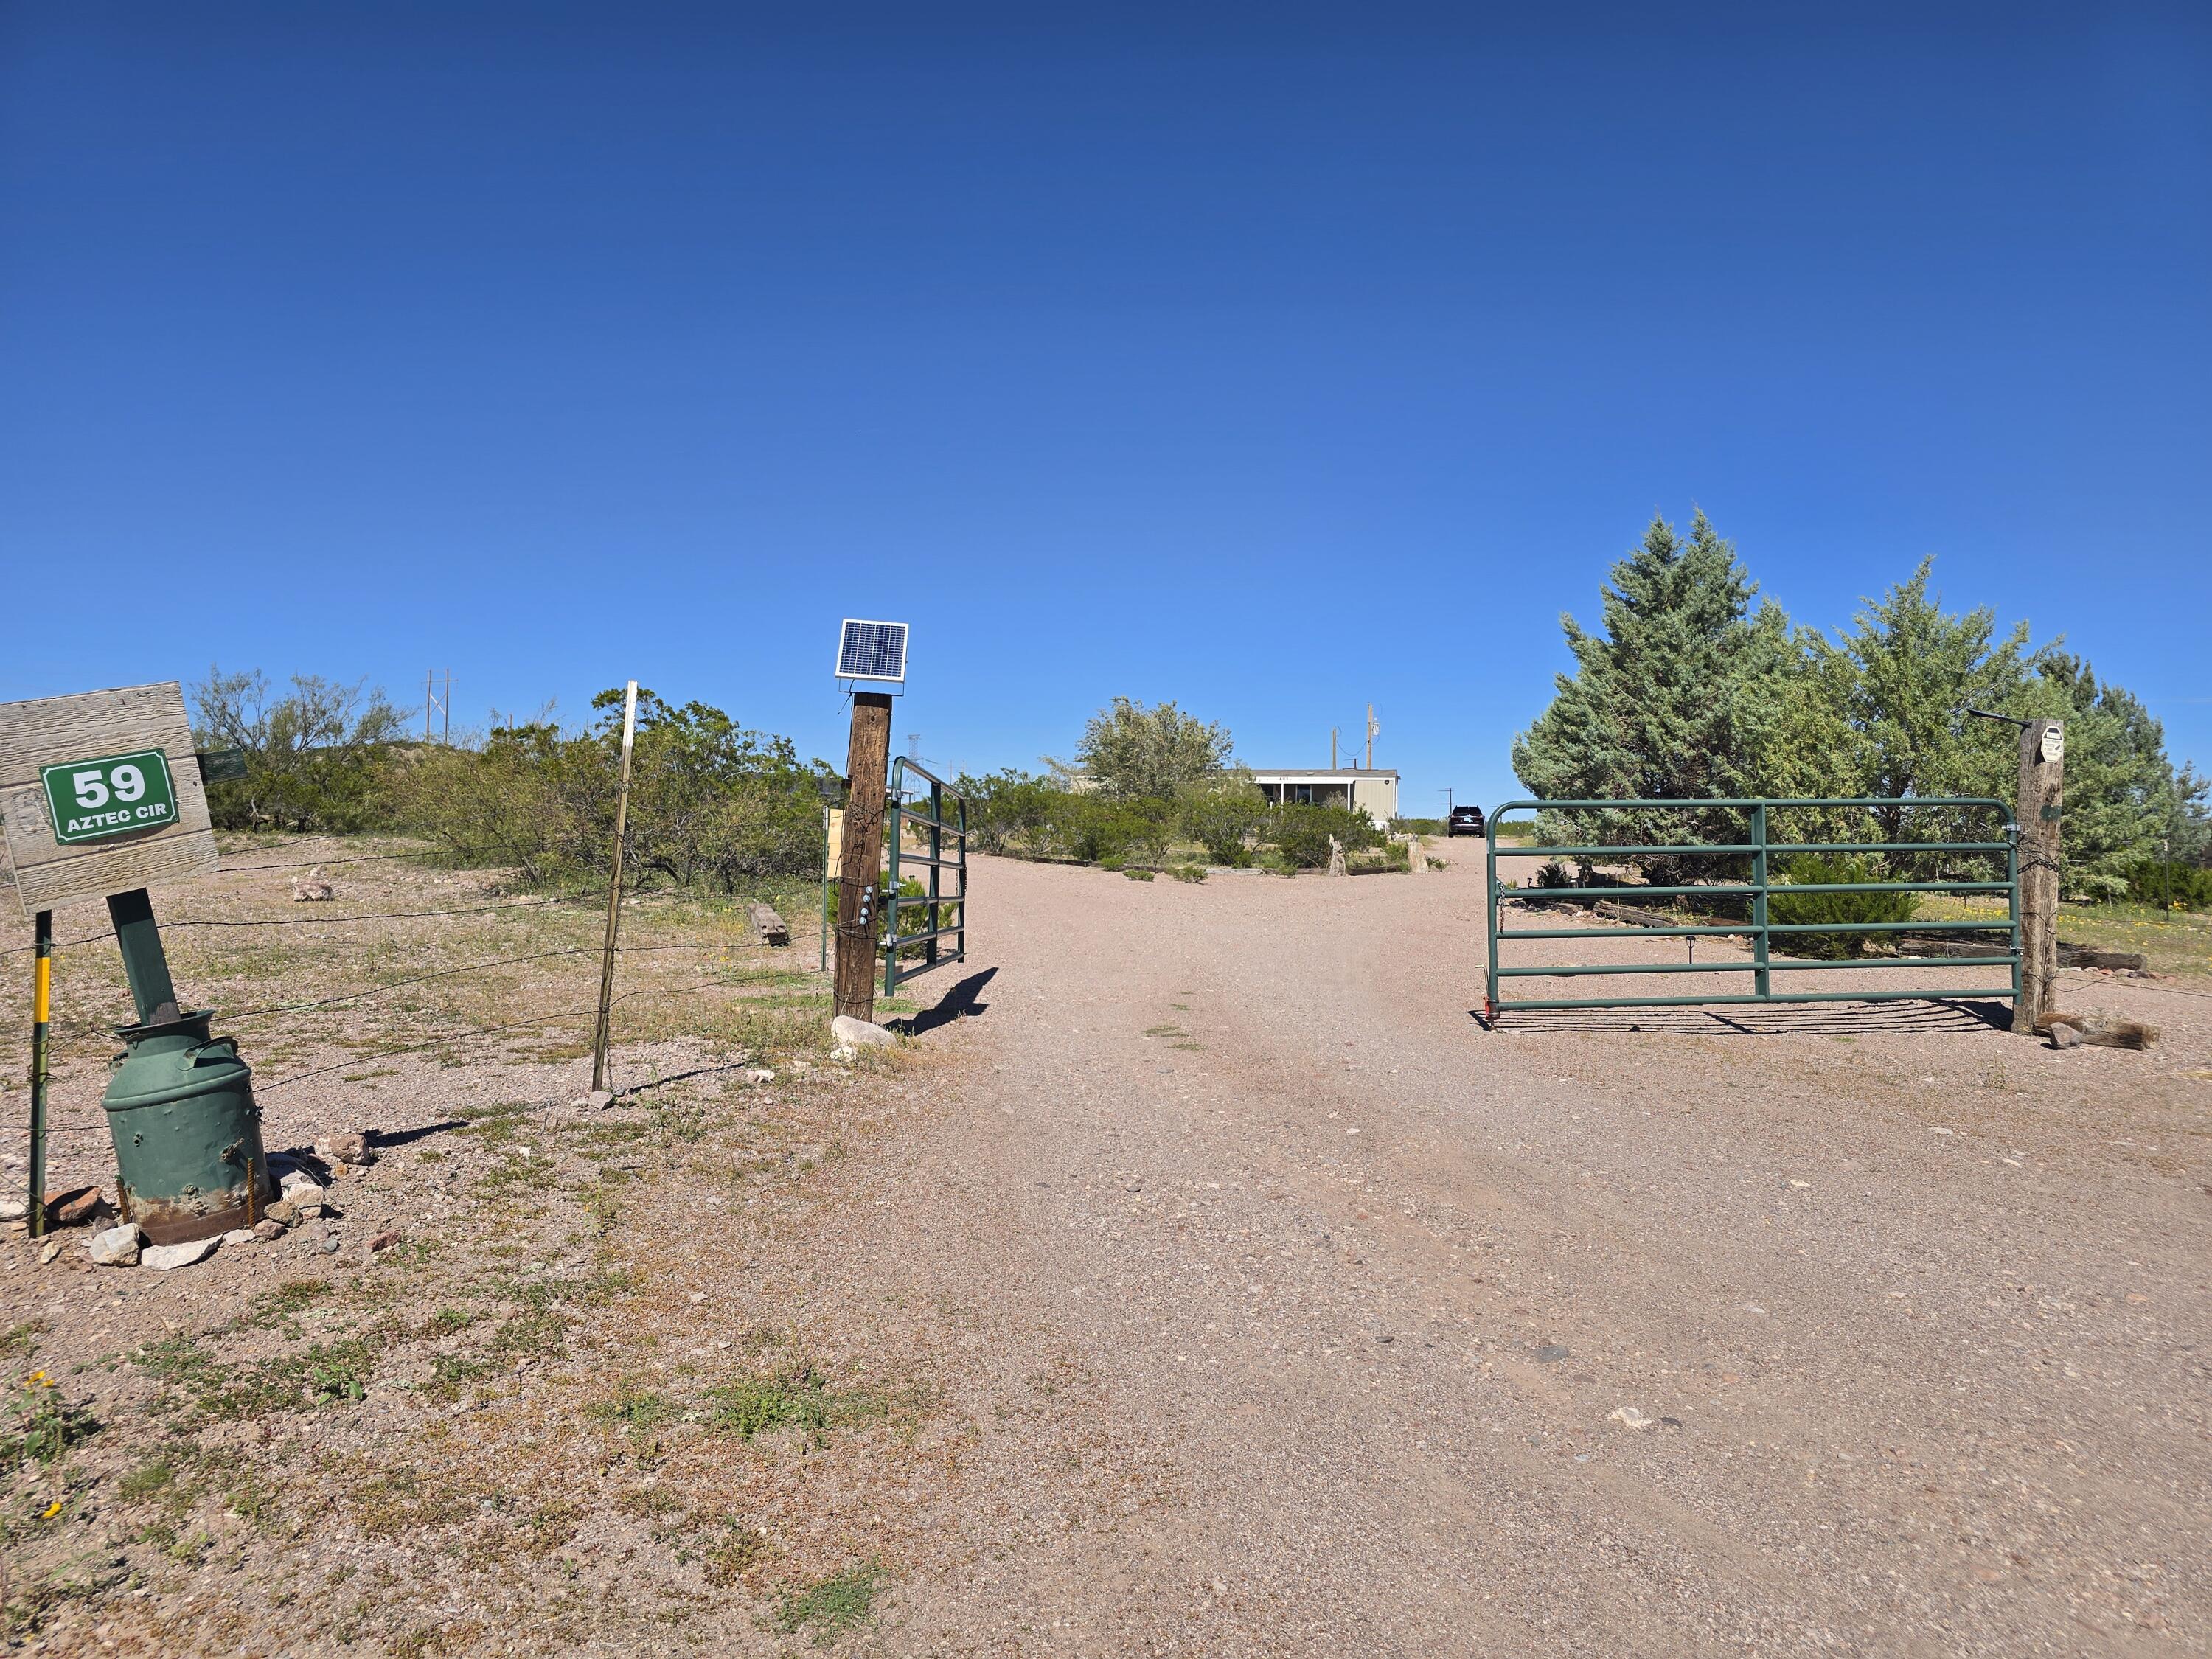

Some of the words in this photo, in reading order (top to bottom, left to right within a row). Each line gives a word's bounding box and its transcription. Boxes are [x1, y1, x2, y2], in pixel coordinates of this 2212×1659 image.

[73, 765, 145, 808] 59
[67, 810, 131, 832] AZTEC
[136, 803, 167, 818] CIR
